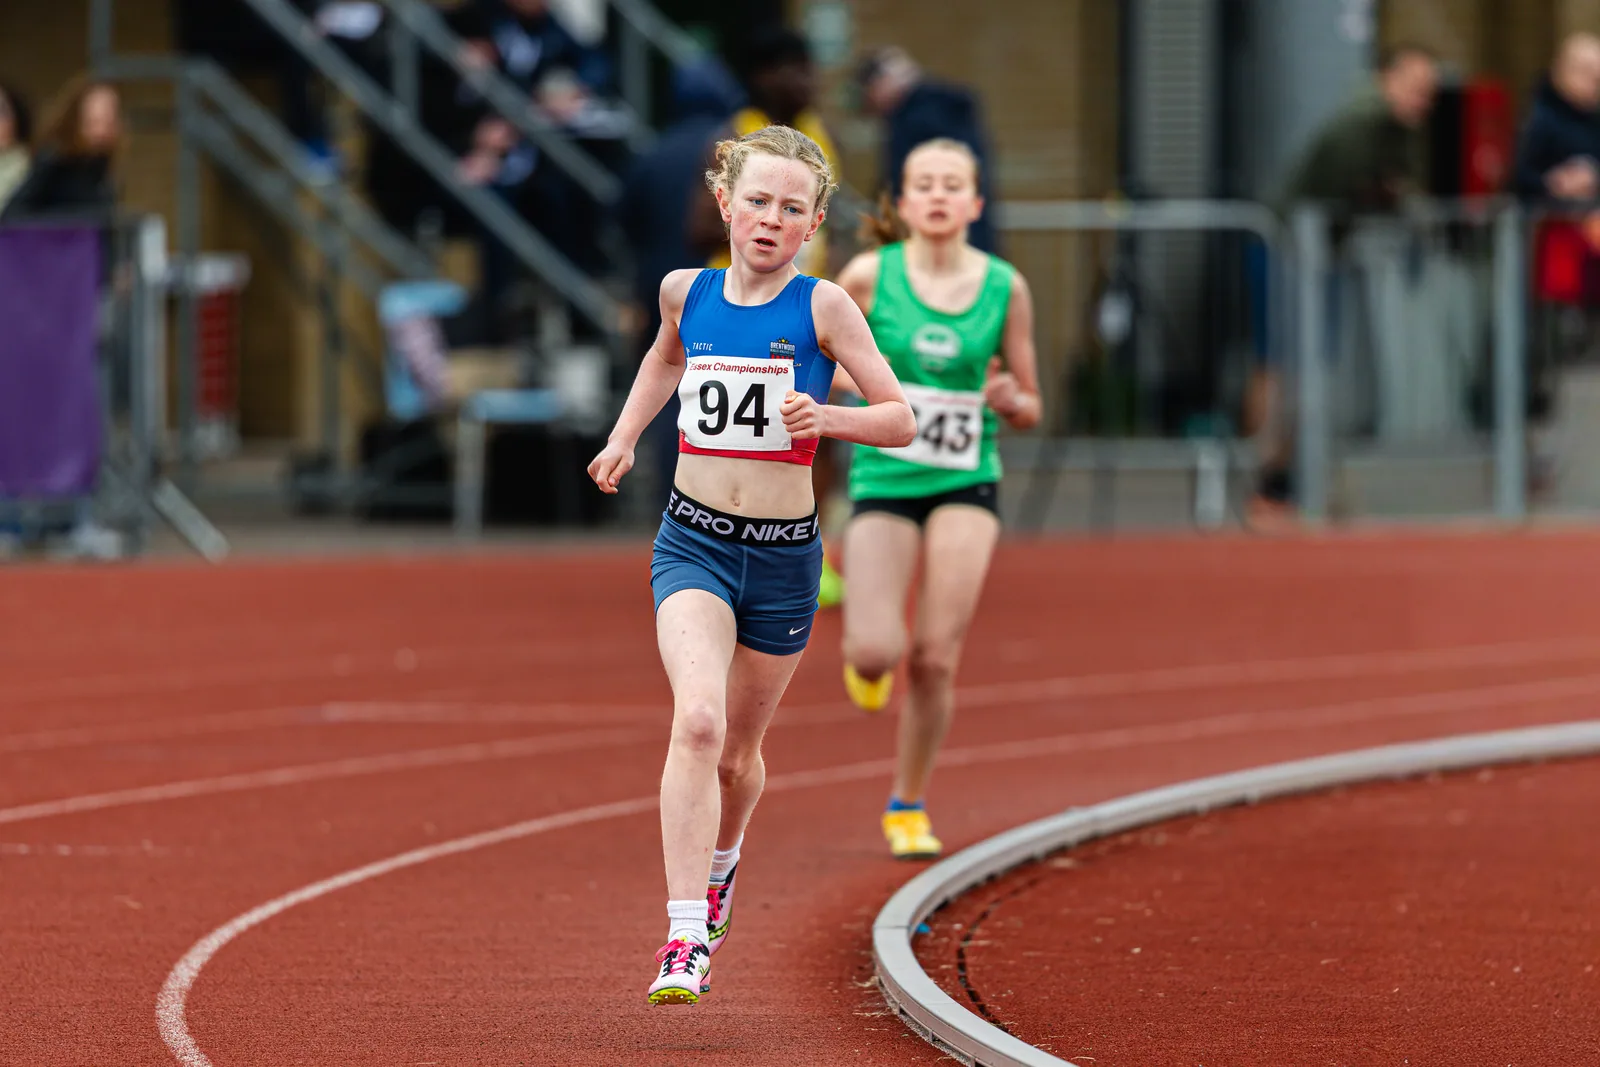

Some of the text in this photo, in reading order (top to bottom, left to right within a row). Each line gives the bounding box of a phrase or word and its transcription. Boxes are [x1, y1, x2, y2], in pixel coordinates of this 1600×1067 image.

[692, 342, 713, 351] TACTIC
[770, 341, 796, 352] BRENTWOOD
[689, 362, 789, 375] Essex Championships
[697, 379, 770, 438] 94
[911, 404, 973, 454] 43
[674, 500, 735, 535] PRO
[741, 520, 812, 542] NIKE
